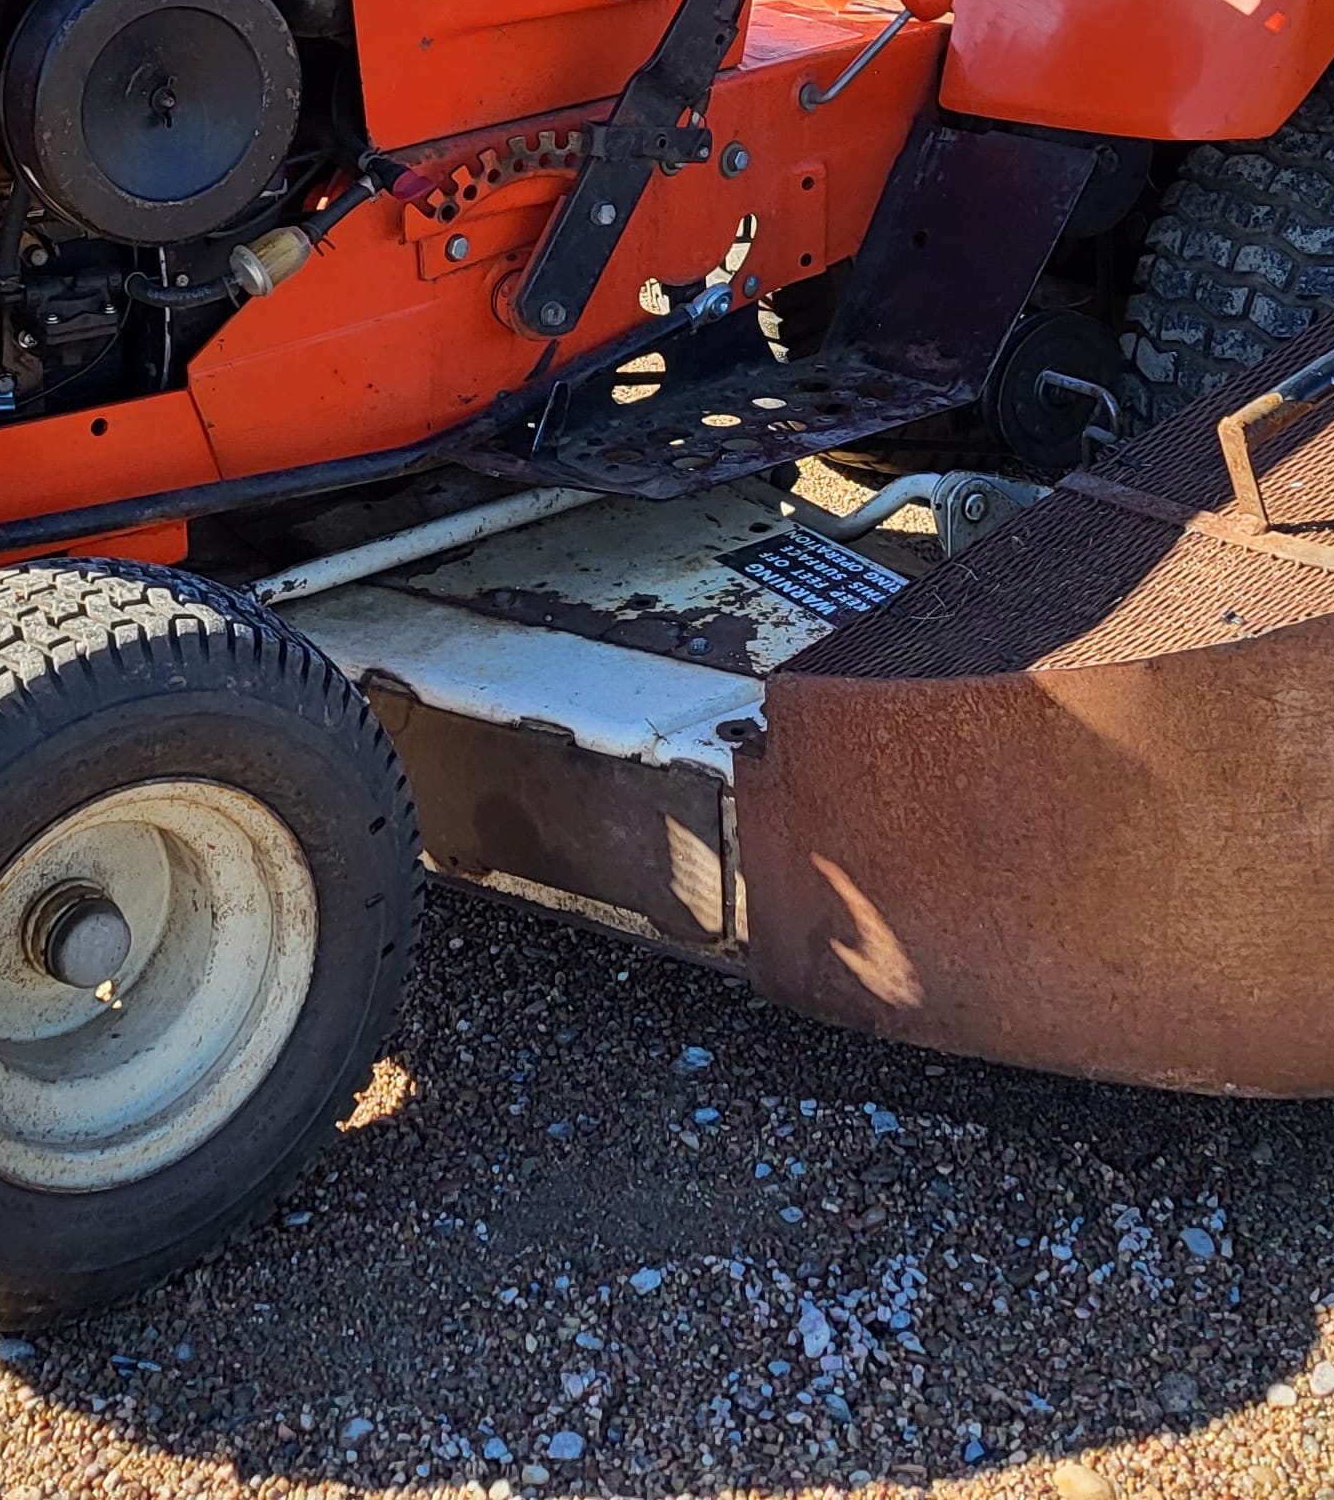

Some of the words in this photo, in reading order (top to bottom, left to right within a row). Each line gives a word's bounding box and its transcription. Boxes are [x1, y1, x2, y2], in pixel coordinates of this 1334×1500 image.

[758, 552, 790, 568] OFF
[784, 530, 864, 572] OPERATION
[780, 545, 848, 581] SURFACE
[745, 563, 838, 615] WARNING
[790, 568, 830, 589] FEET
[829, 590, 871, 612] KEEP
[848, 581, 888, 603] THIS
